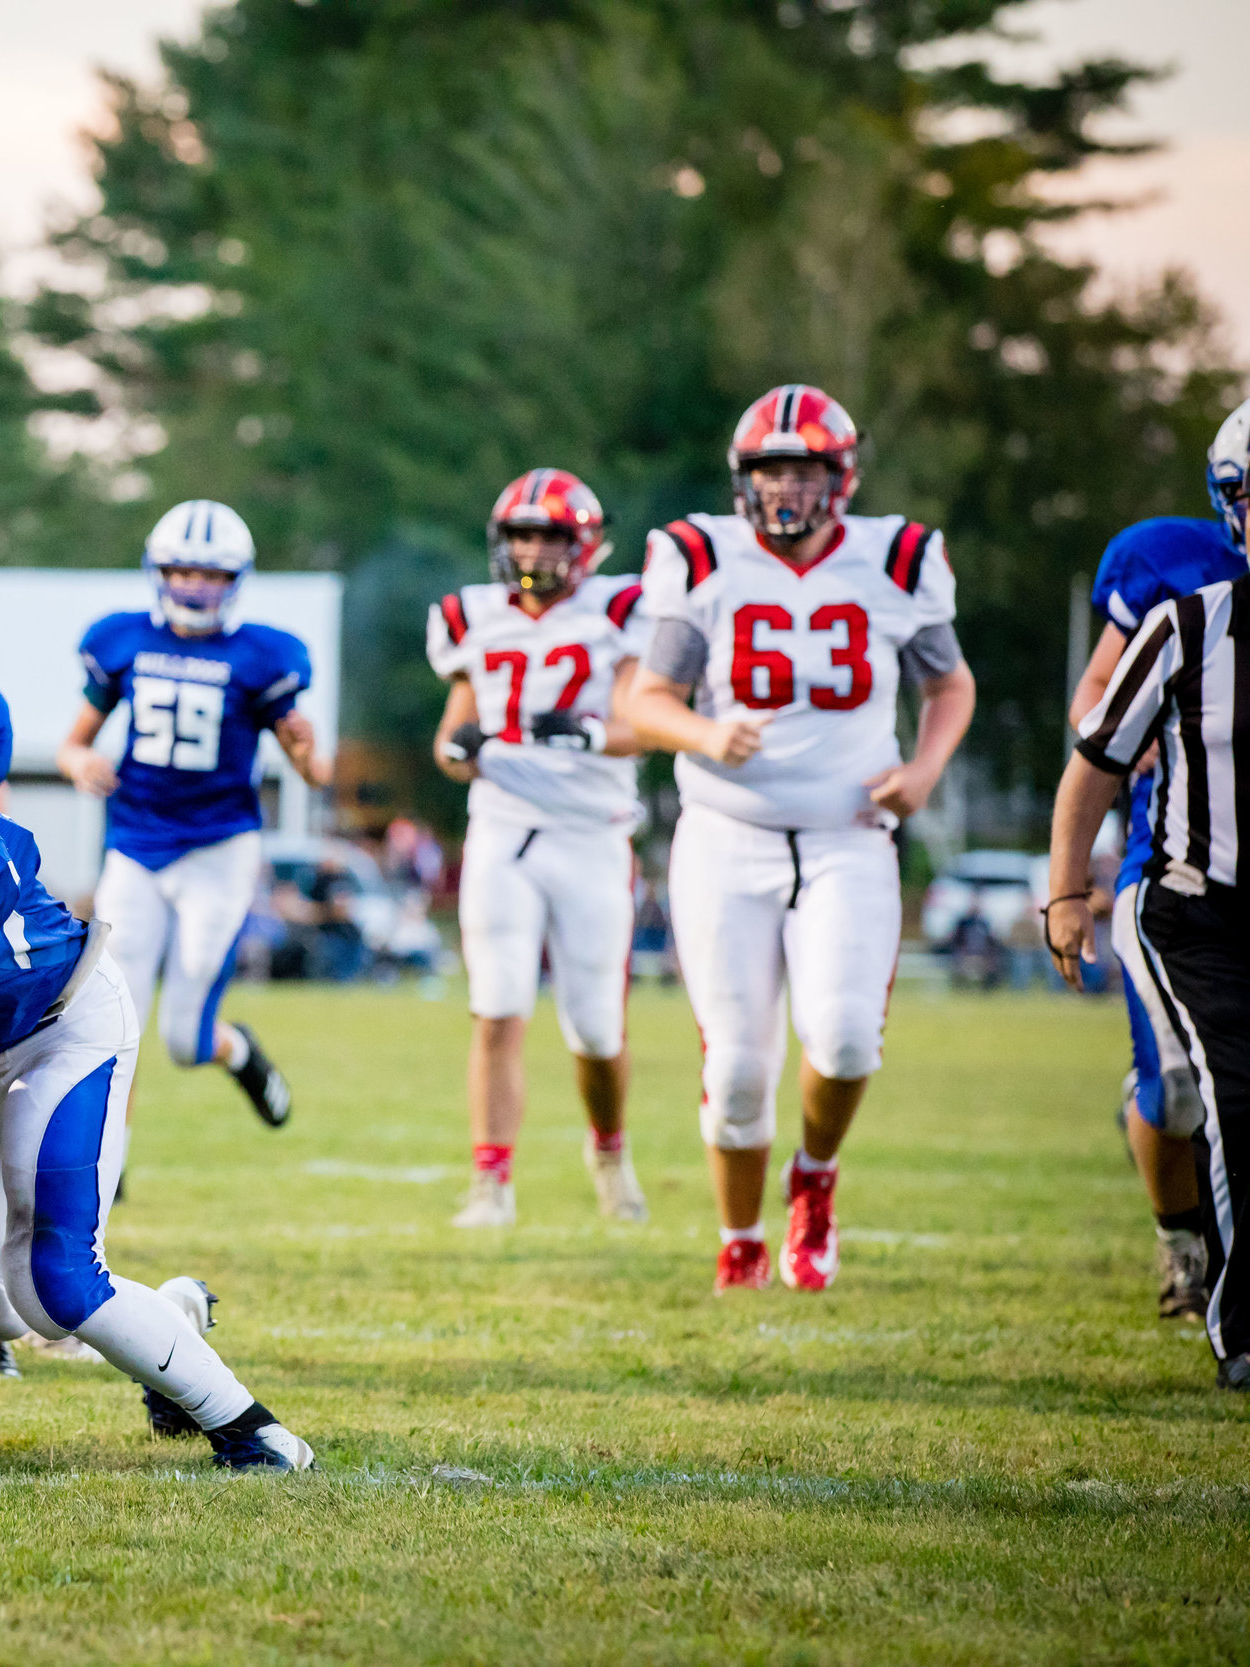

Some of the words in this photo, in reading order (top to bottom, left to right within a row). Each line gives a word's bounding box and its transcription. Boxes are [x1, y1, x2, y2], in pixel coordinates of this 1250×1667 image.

[484, 643, 592, 745] 72
[729, 602, 874, 712] 63
[132, 675, 226, 772] 59
